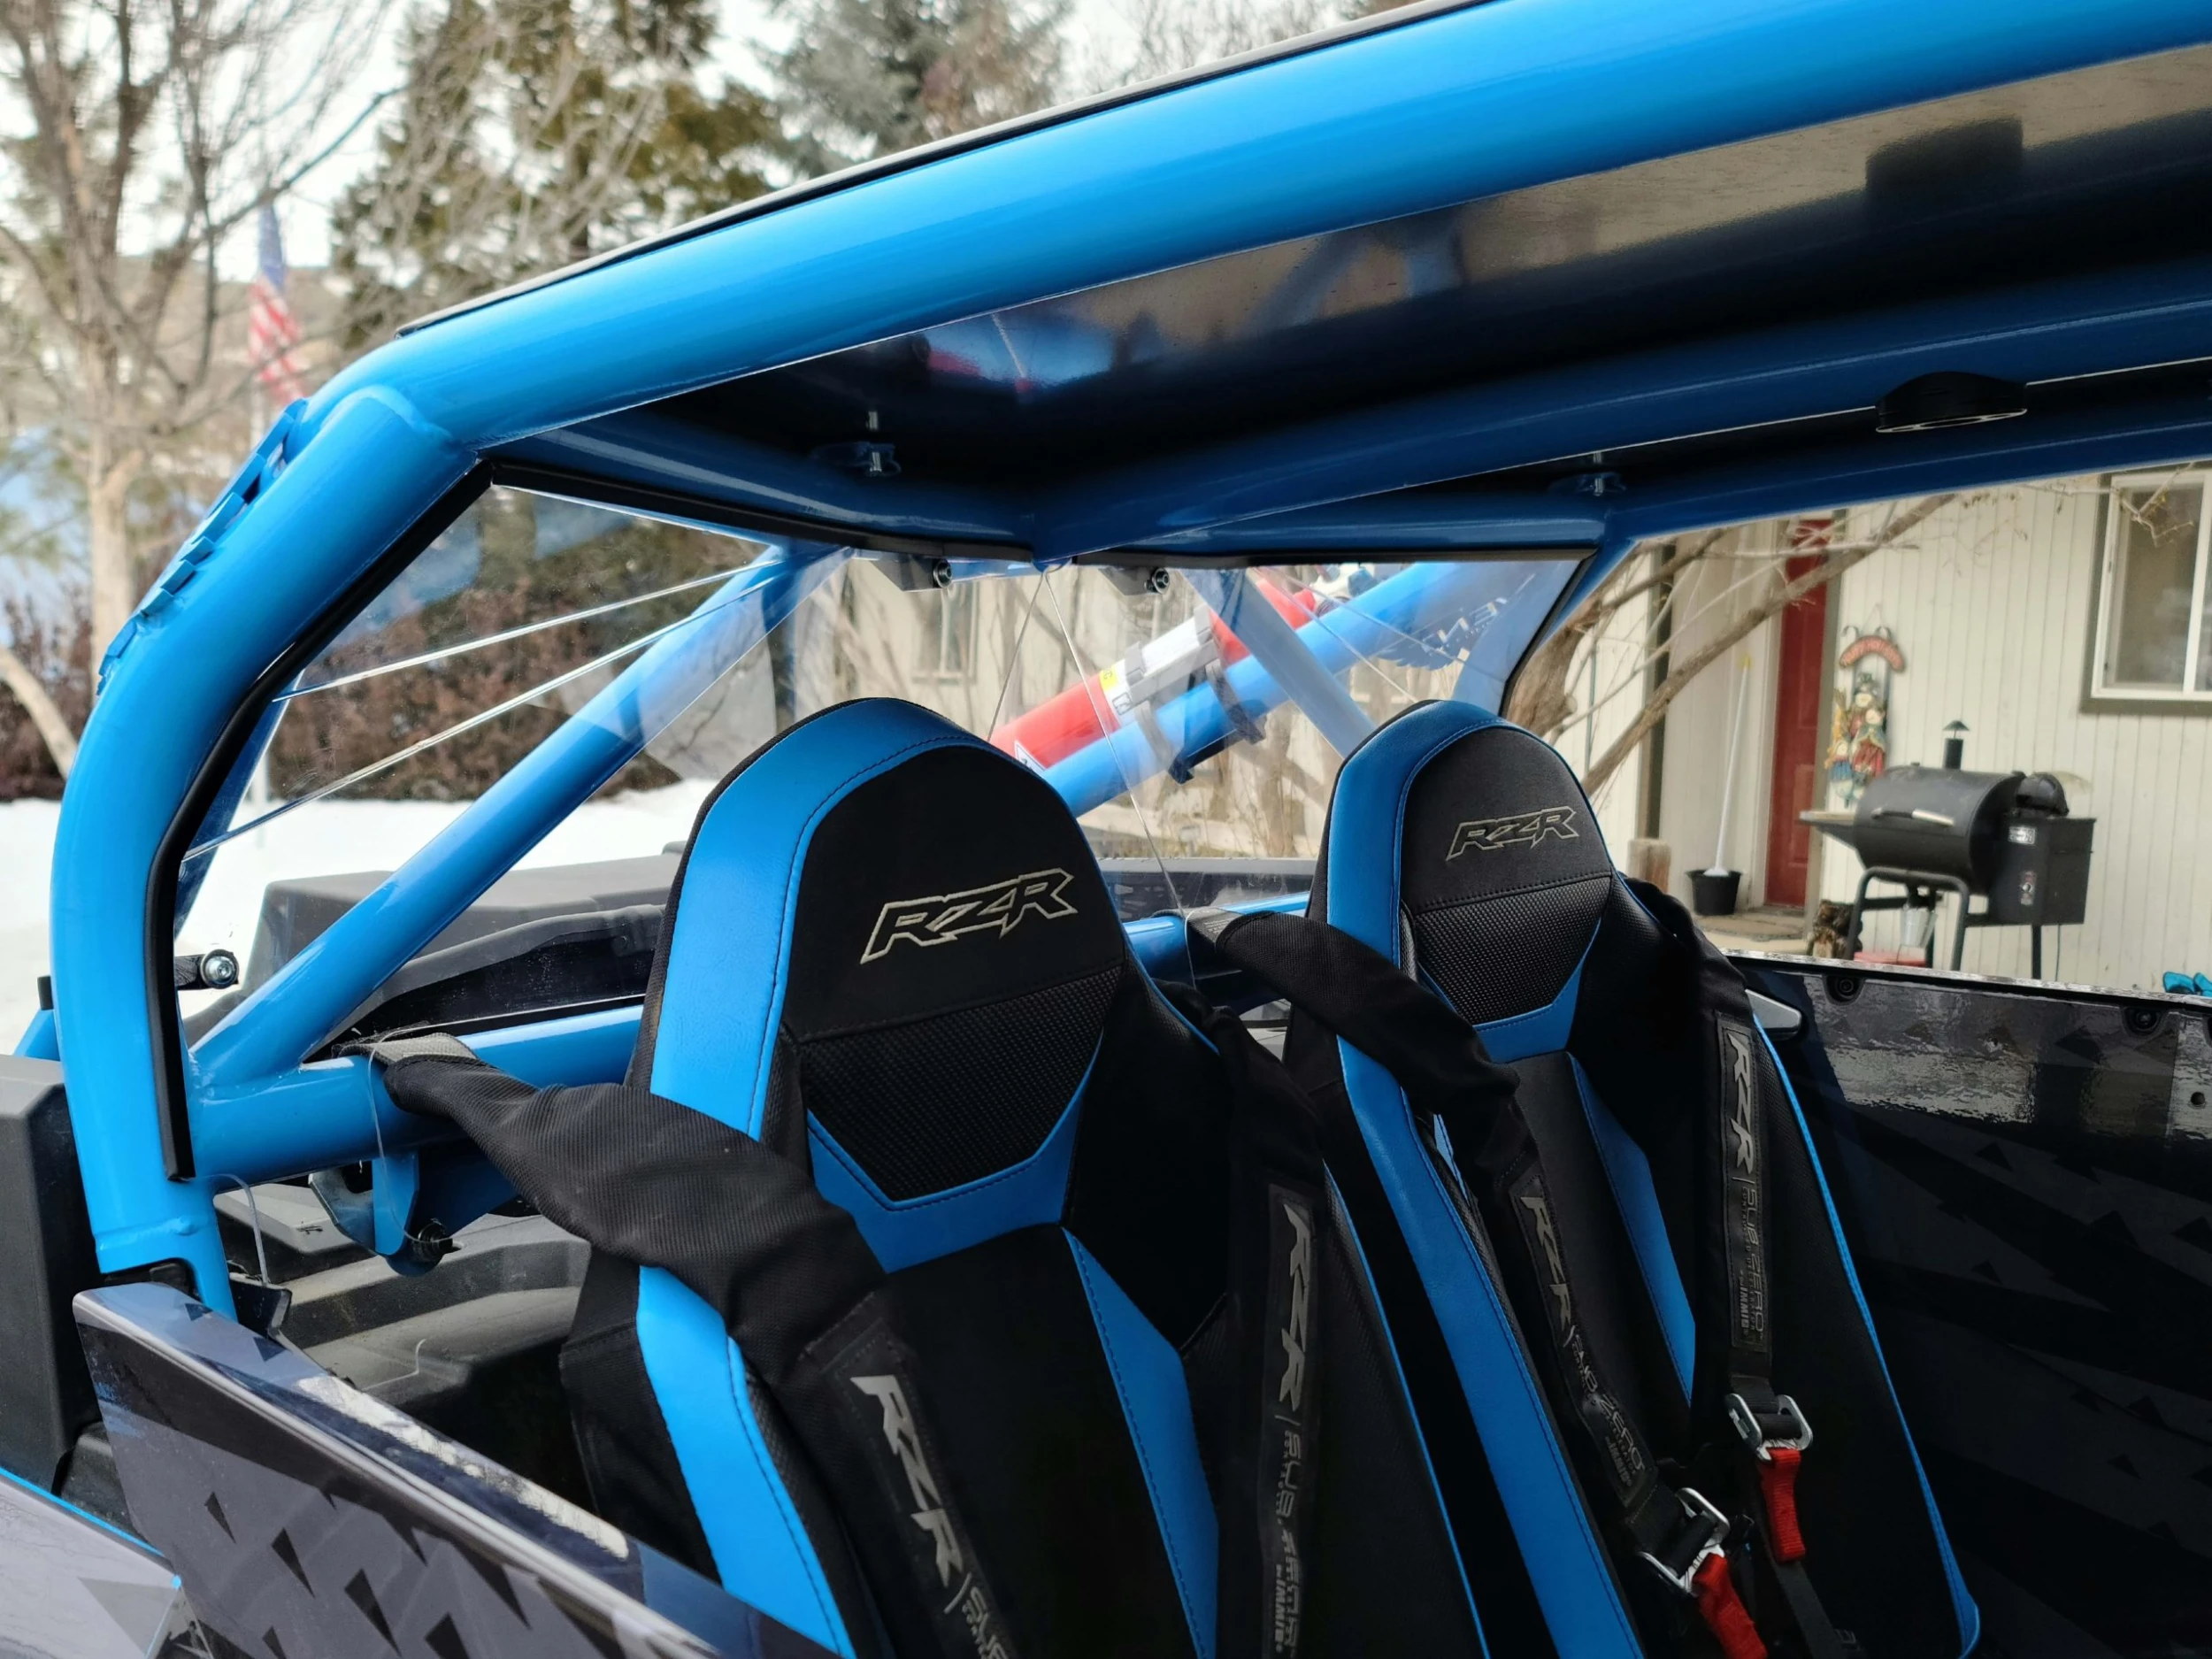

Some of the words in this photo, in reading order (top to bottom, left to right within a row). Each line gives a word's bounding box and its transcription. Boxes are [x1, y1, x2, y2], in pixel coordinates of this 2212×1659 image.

[1445, 805, 1579, 862] RZR
[859, 867, 1079, 965] RZR
[1727, 1033, 1755, 1177] RZR
[1520, 1196, 1571, 1333] RZR
[1747, 1188, 1759, 1246] SUB
[1279, 1203, 1310, 1412] RZR
[1751, 1253, 1764, 1333] ZERO
[849, 1374, 963, 1588] RZR
